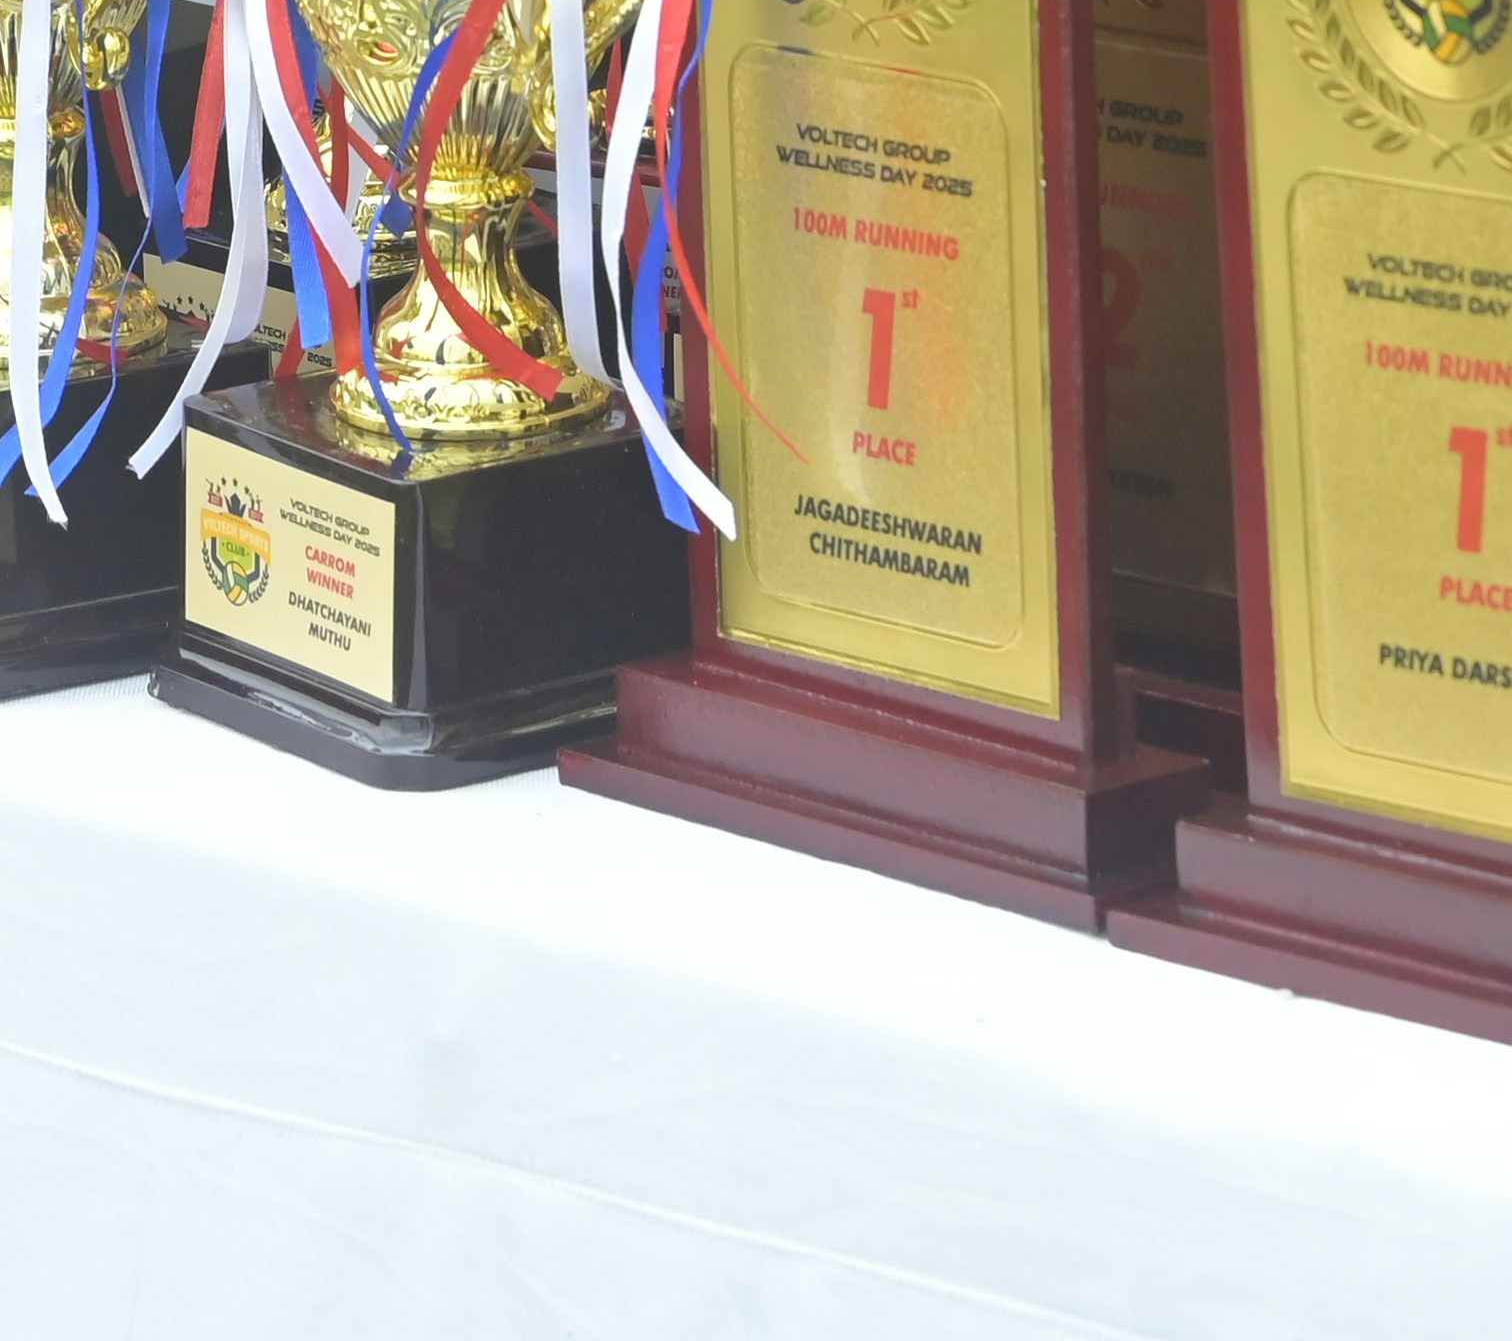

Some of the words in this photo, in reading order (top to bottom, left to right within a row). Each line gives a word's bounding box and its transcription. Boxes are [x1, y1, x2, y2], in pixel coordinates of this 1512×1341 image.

[797, 122, 878, 154] VOLTECH
[882, 138, 951, 165] GROUP
[1106, 125, 1148, 149] DAY
[776, 144, 875, 180] WELLNESS
[880, 165, 917, 186] DAY
[922, 174, 972, 197] 2025
[792, 207, 848, 240] 100M
[854, 223, 961, 262] RUNNING
[1368, 253, 1464, 284] VOLTECH
[1343, 277, 1462, 312] WELLNESS
[1468, 295, 1511, 319] DAY
[307, 352, 332, 367] 2025
[1365, 341, 1429, 375] 100M
[853, 430, 916, 467] PLACE
[280, 509, 331, 538] WELLNESS
[333, 528, 352, 545] DAY
[355, 538, 380, 557] 2025
[290, 497, 333, 523] VOLTECH
[335, 514, 370, 537] GROUP
[794, 494, 982, 555] JAGADEESHWARAN
[203, 518, 238, 539] VOLTECH
[239, 526, 269, 552] SPORTS
[226, 541, 246, 558] CLUB
[305, 545, 355, 577] CARROM
[809, 532, 970, 587] CHITHAMBARAM
[307, 568, 354, 599] WINNER
[288, 591, 371, 637] DHATCHAYANI
[308, 622, 351, 651] MUTHU
[1379, 643, 1444, 676] PRIYA
